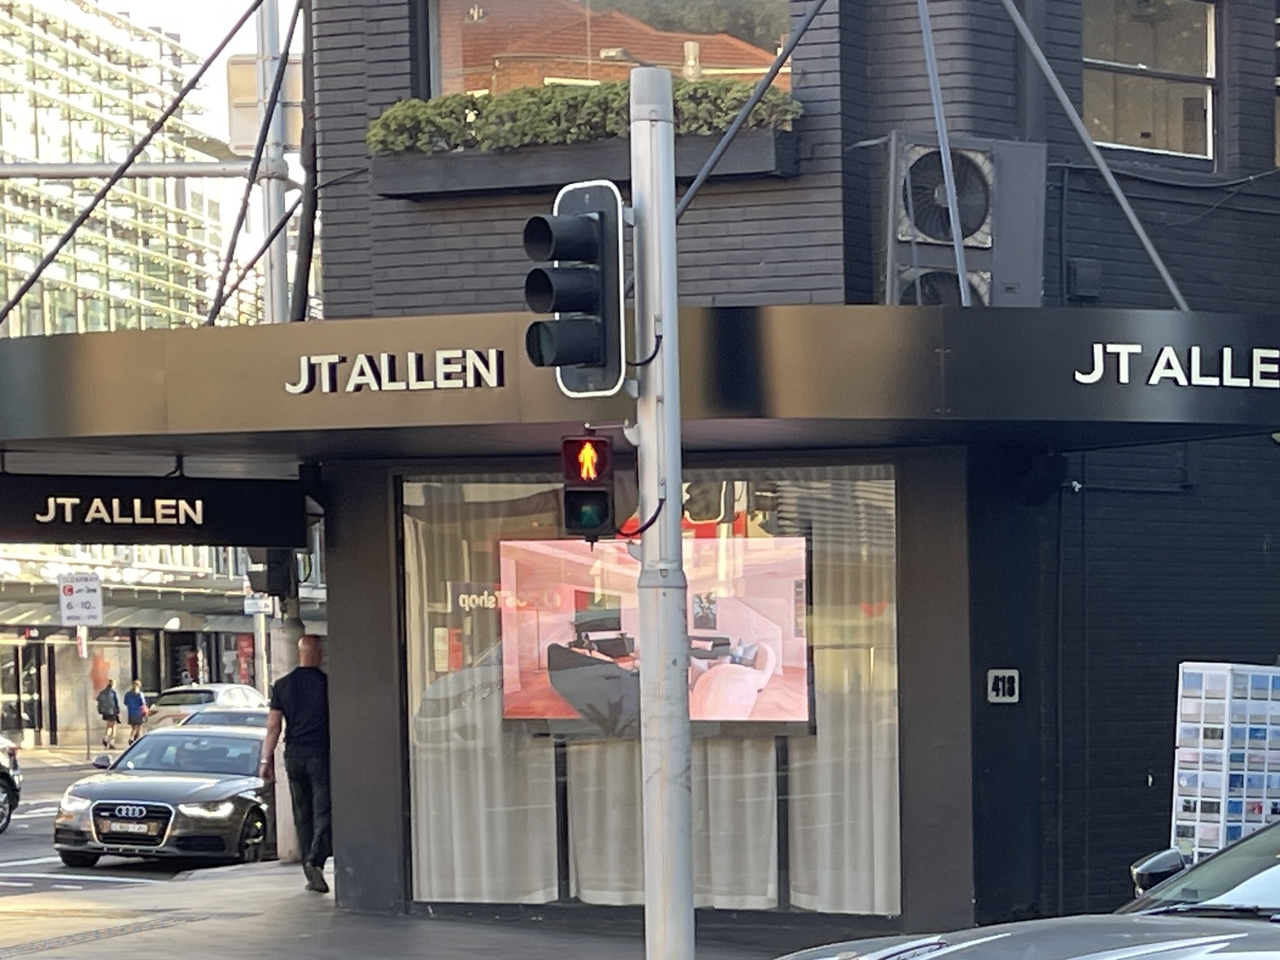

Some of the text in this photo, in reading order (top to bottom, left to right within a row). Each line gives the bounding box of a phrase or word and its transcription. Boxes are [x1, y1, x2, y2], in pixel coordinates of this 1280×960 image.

[284, 348, 500, 394] JT ALLEN
[1074, 343, 1142, 384] JT
[35, 497, 203, 525] JT ALLEN
